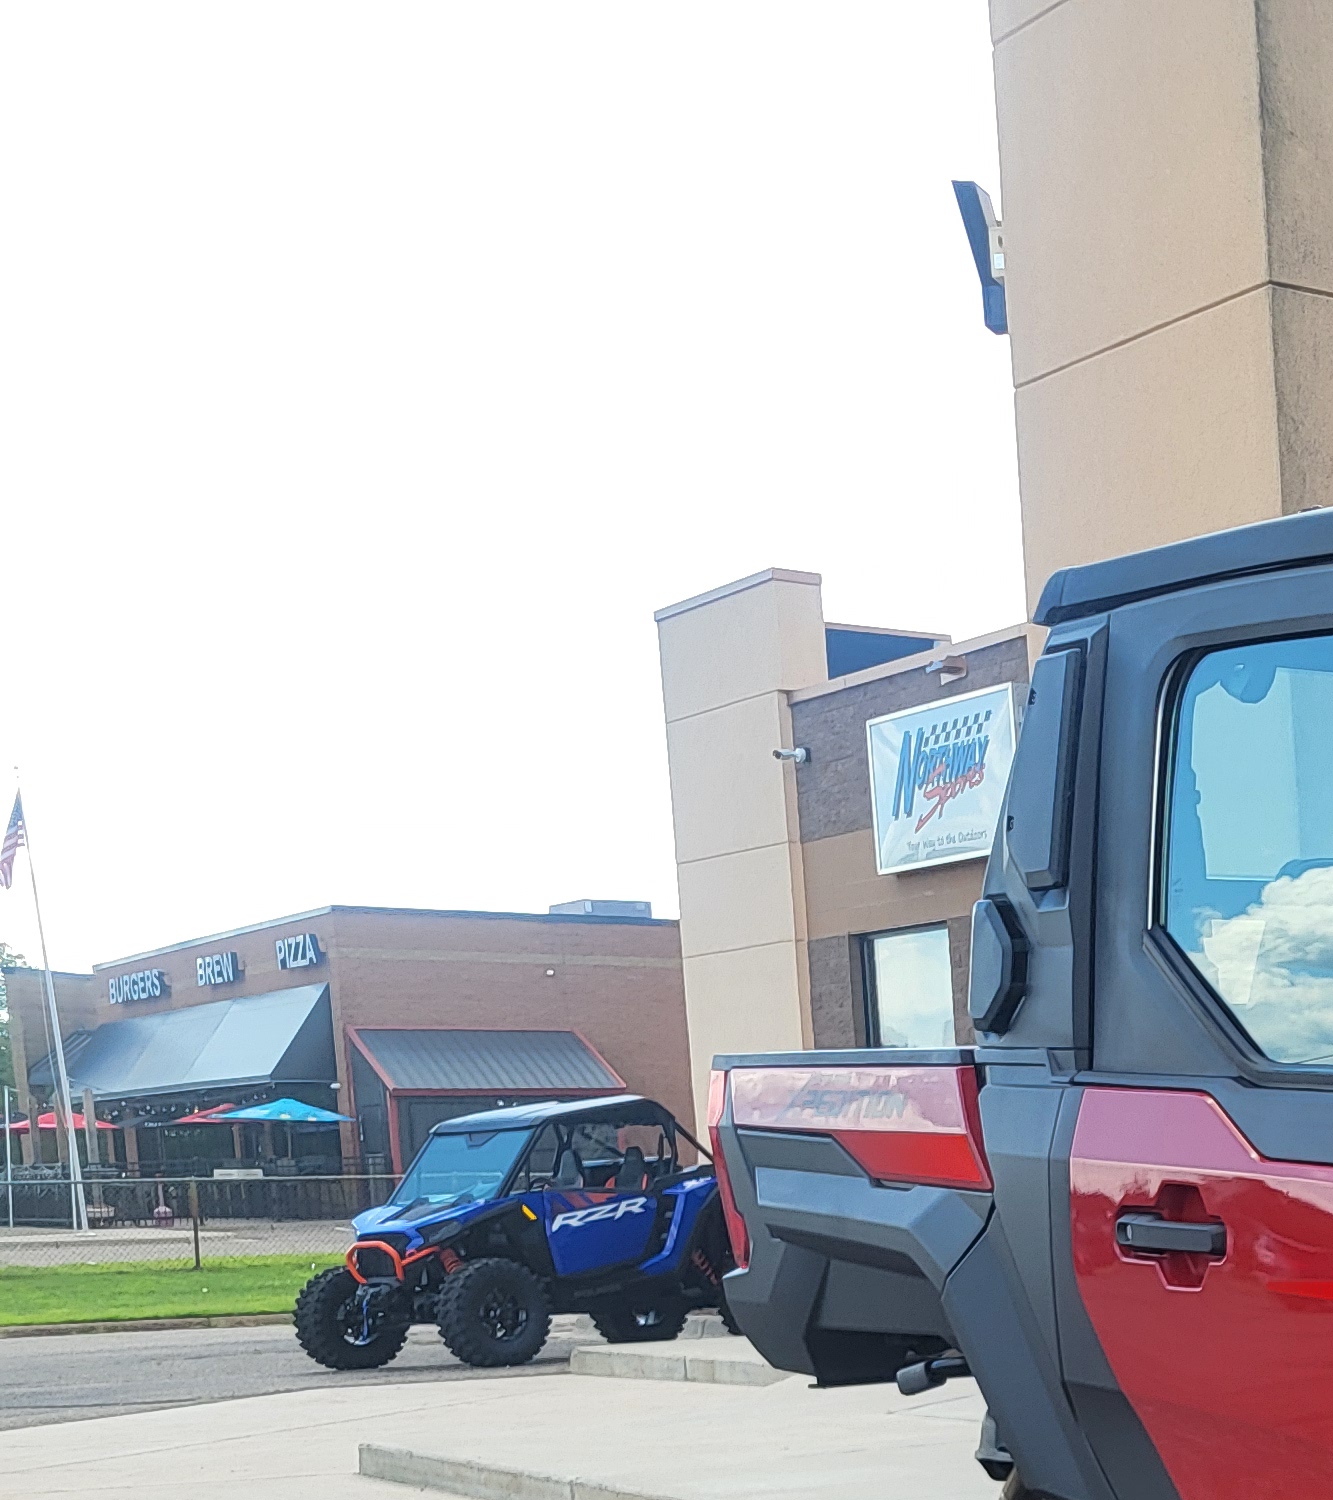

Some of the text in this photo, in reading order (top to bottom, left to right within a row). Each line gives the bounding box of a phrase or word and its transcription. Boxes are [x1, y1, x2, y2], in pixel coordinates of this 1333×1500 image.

[196, 952, 235, 987] BREW
[275, 932, 317, 970] PIZZA
[108, 968, 162, 1005] BURGERS
[551, 1196, 648, 1233] RZR
